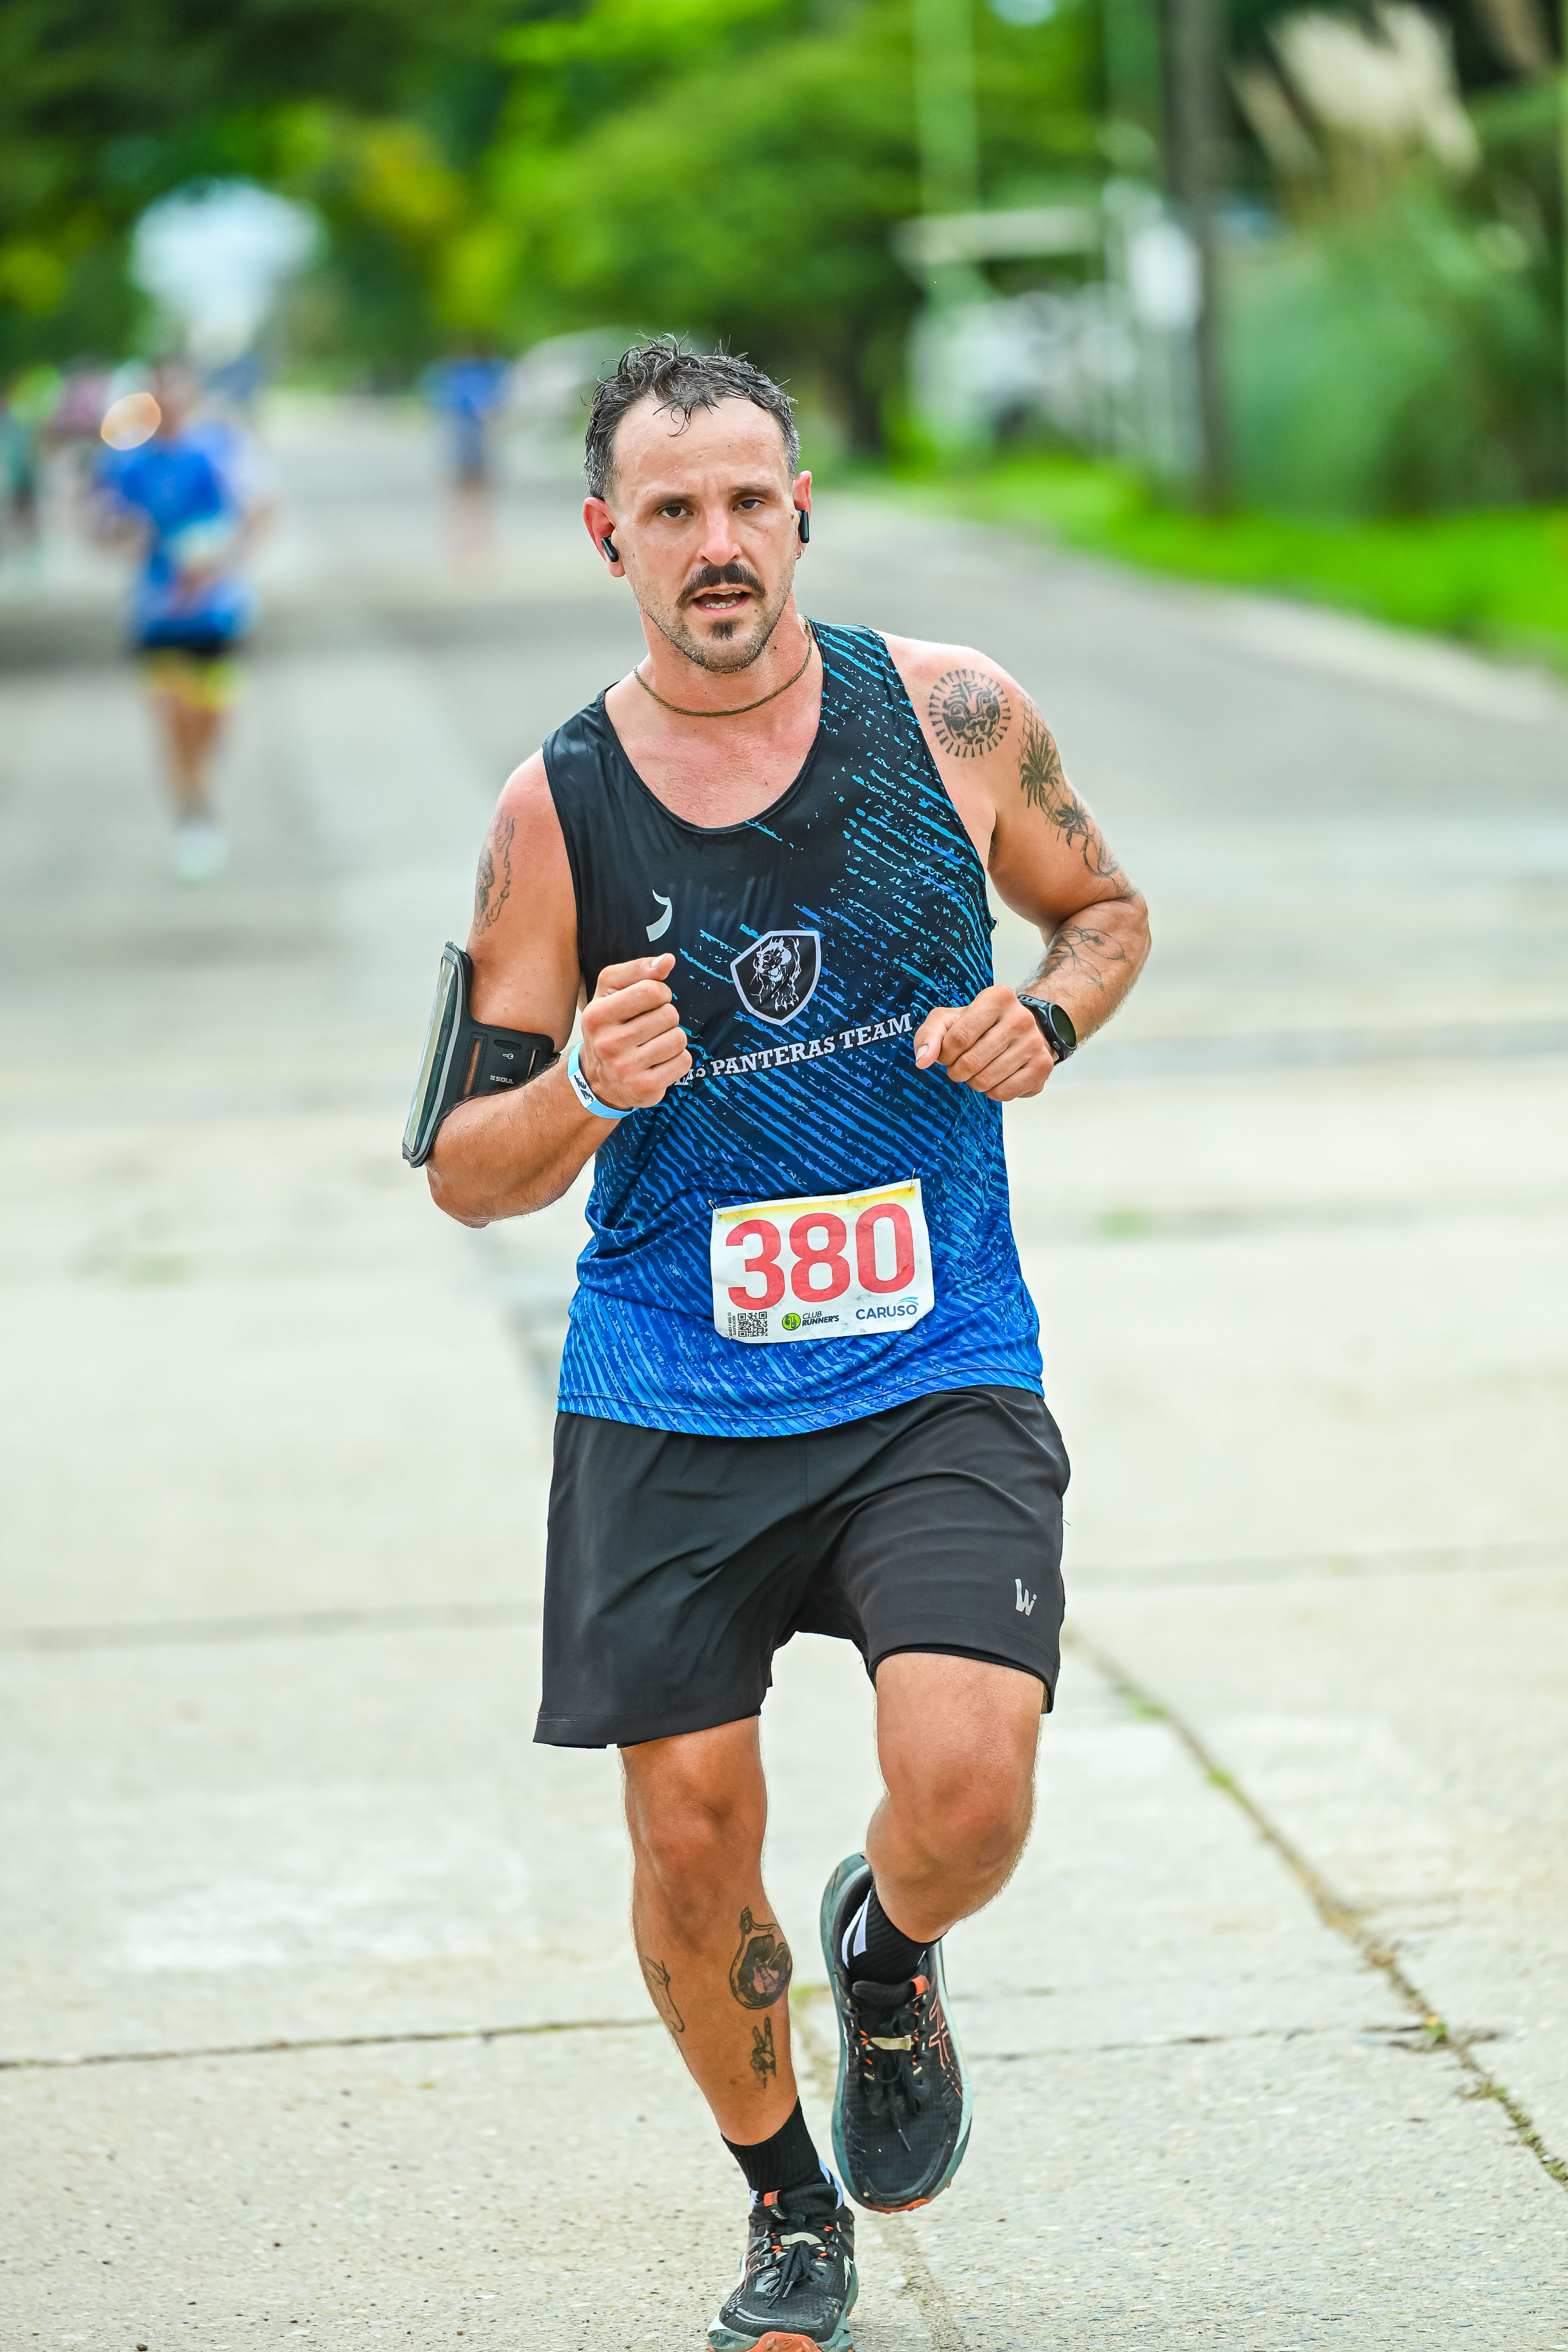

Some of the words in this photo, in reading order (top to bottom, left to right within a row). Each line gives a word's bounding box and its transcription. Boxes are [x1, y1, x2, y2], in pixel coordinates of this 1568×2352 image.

[710, 1036, 835, 1076] PANTERAS
[839, 1013, 913, 1049] TEAM
[726, 1203, 915, 1310] 380
[803, 1311, 822, 1319] CLUB
[856, 1304, 917, 1320] CARUSO
[802, 1315, 839, 1326] RUNNER'S
